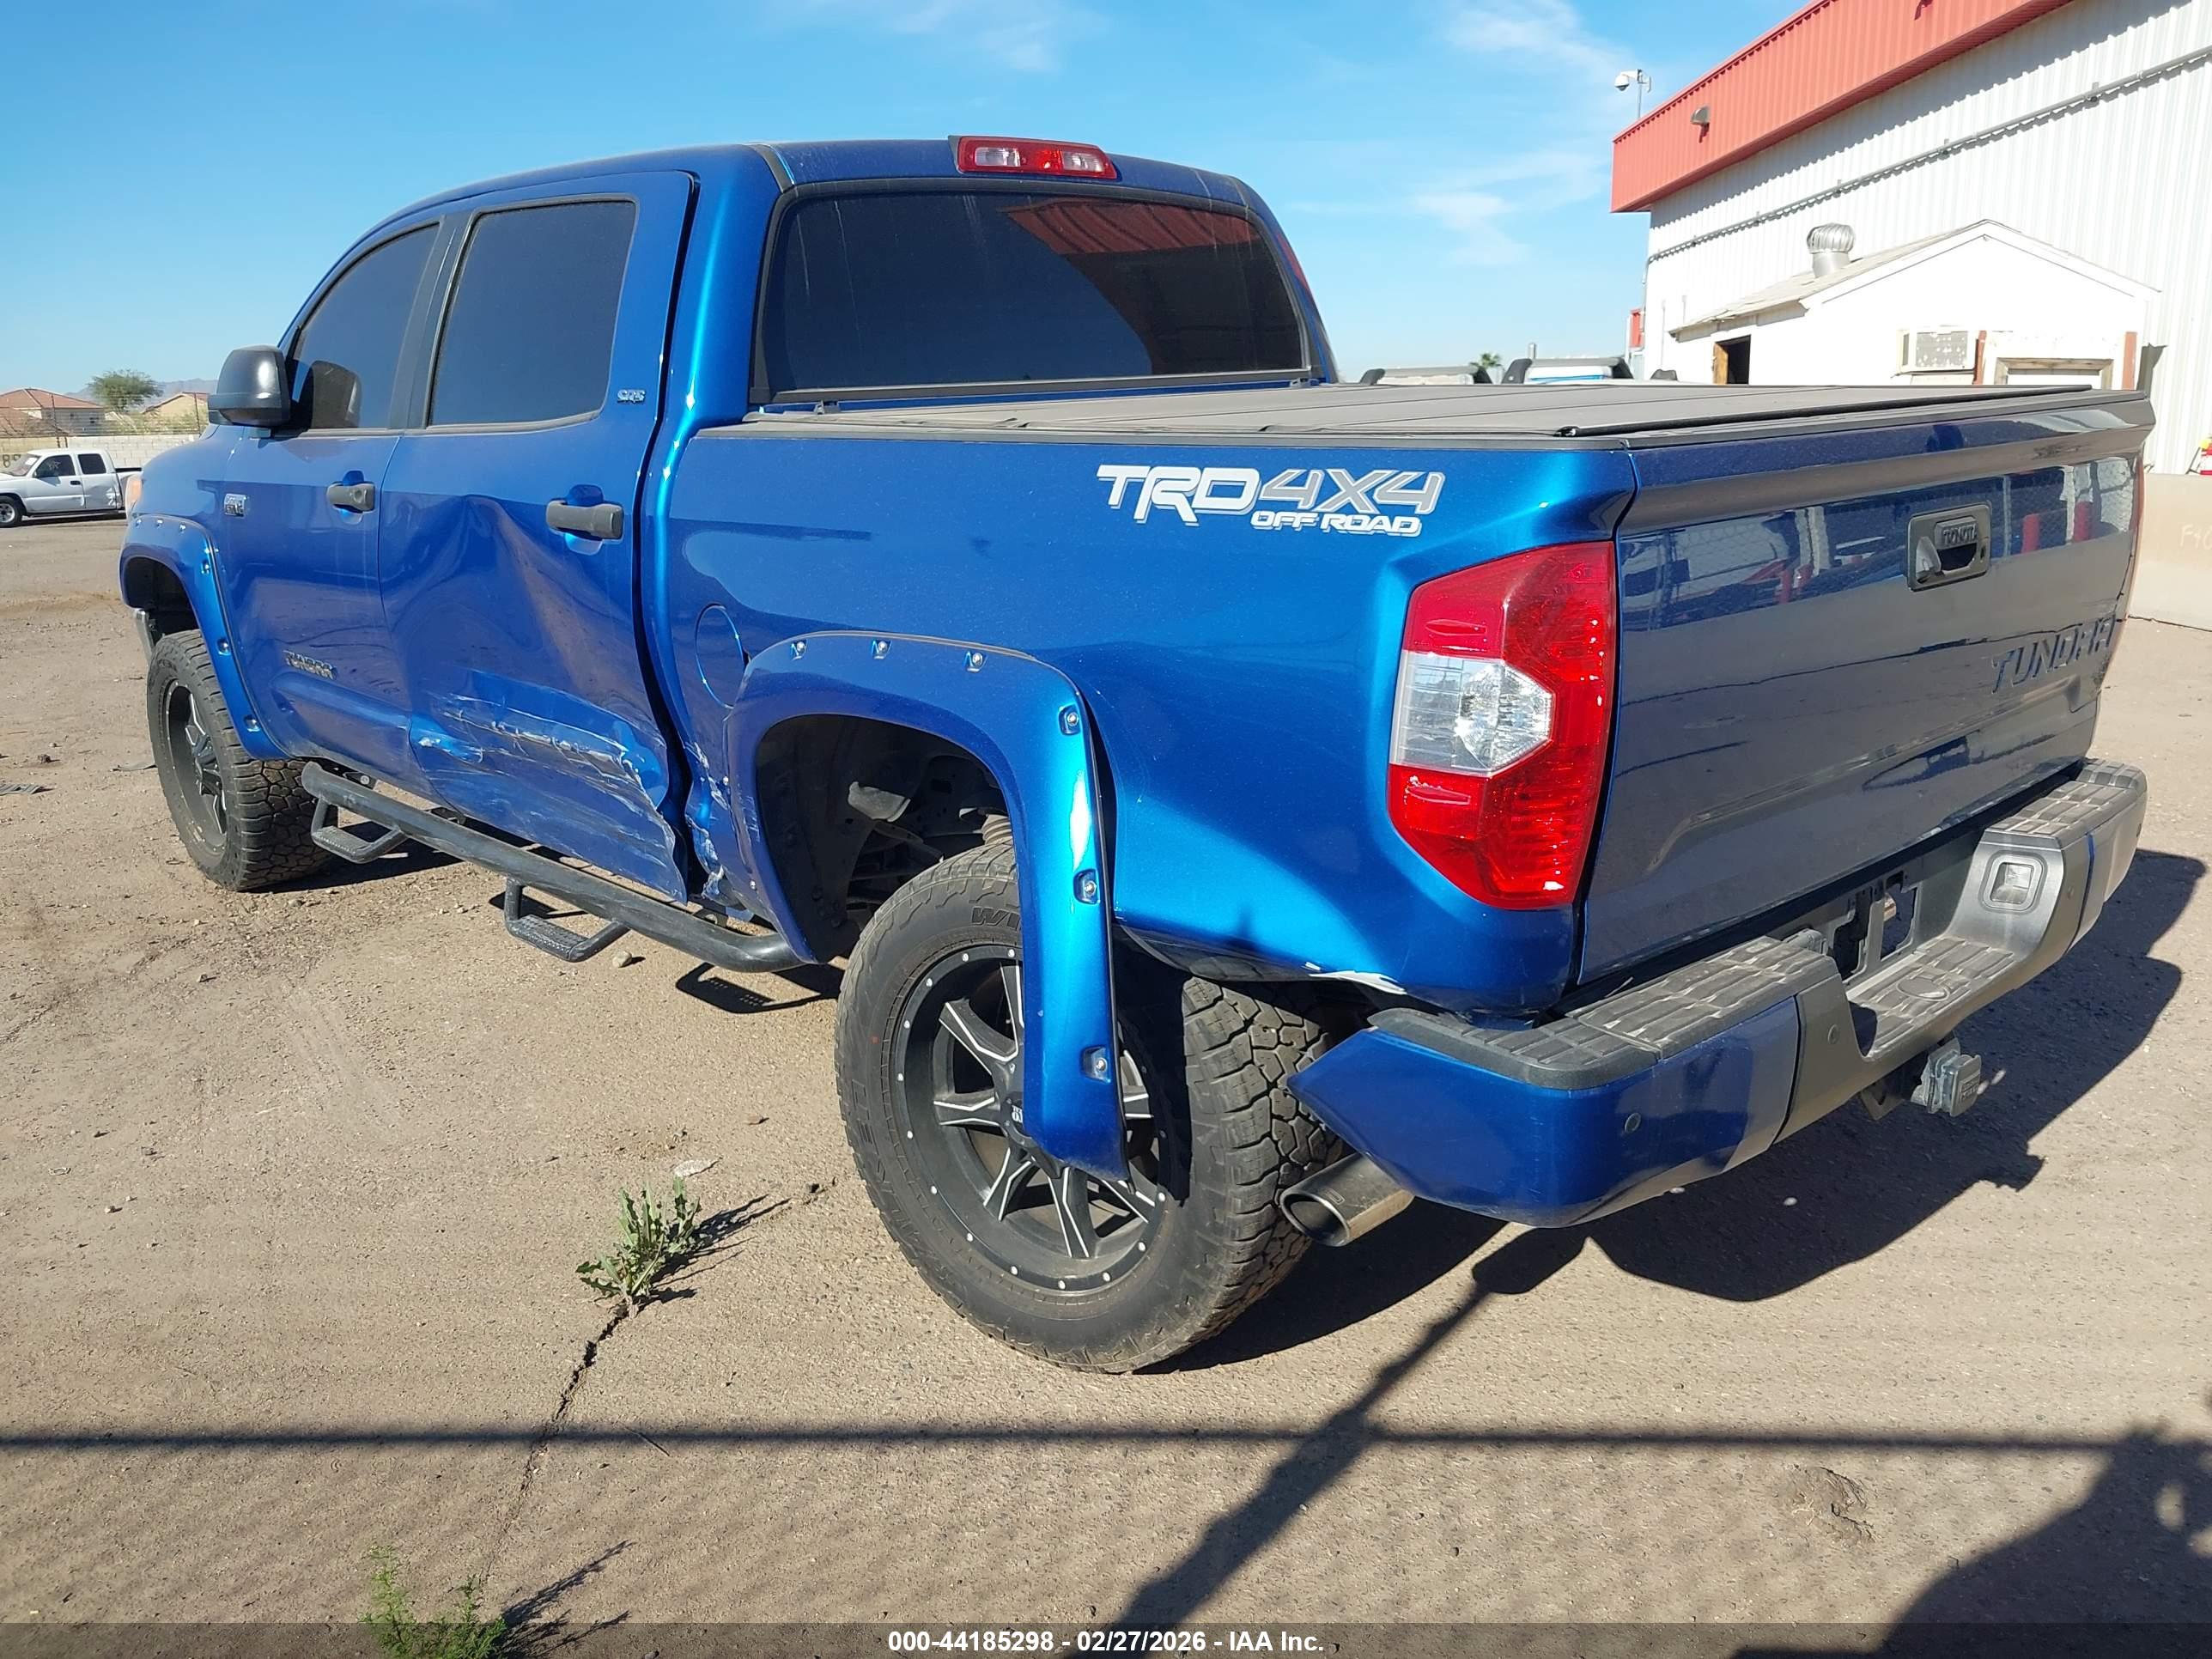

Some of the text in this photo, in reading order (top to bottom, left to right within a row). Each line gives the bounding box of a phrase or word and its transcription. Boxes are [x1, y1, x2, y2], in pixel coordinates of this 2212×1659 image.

[1097, 465, 1262, 526] TRD
[1250, 510, 1423, 538] OFF ROAD
[1990, 613, 2116, 694] TUNDRA
